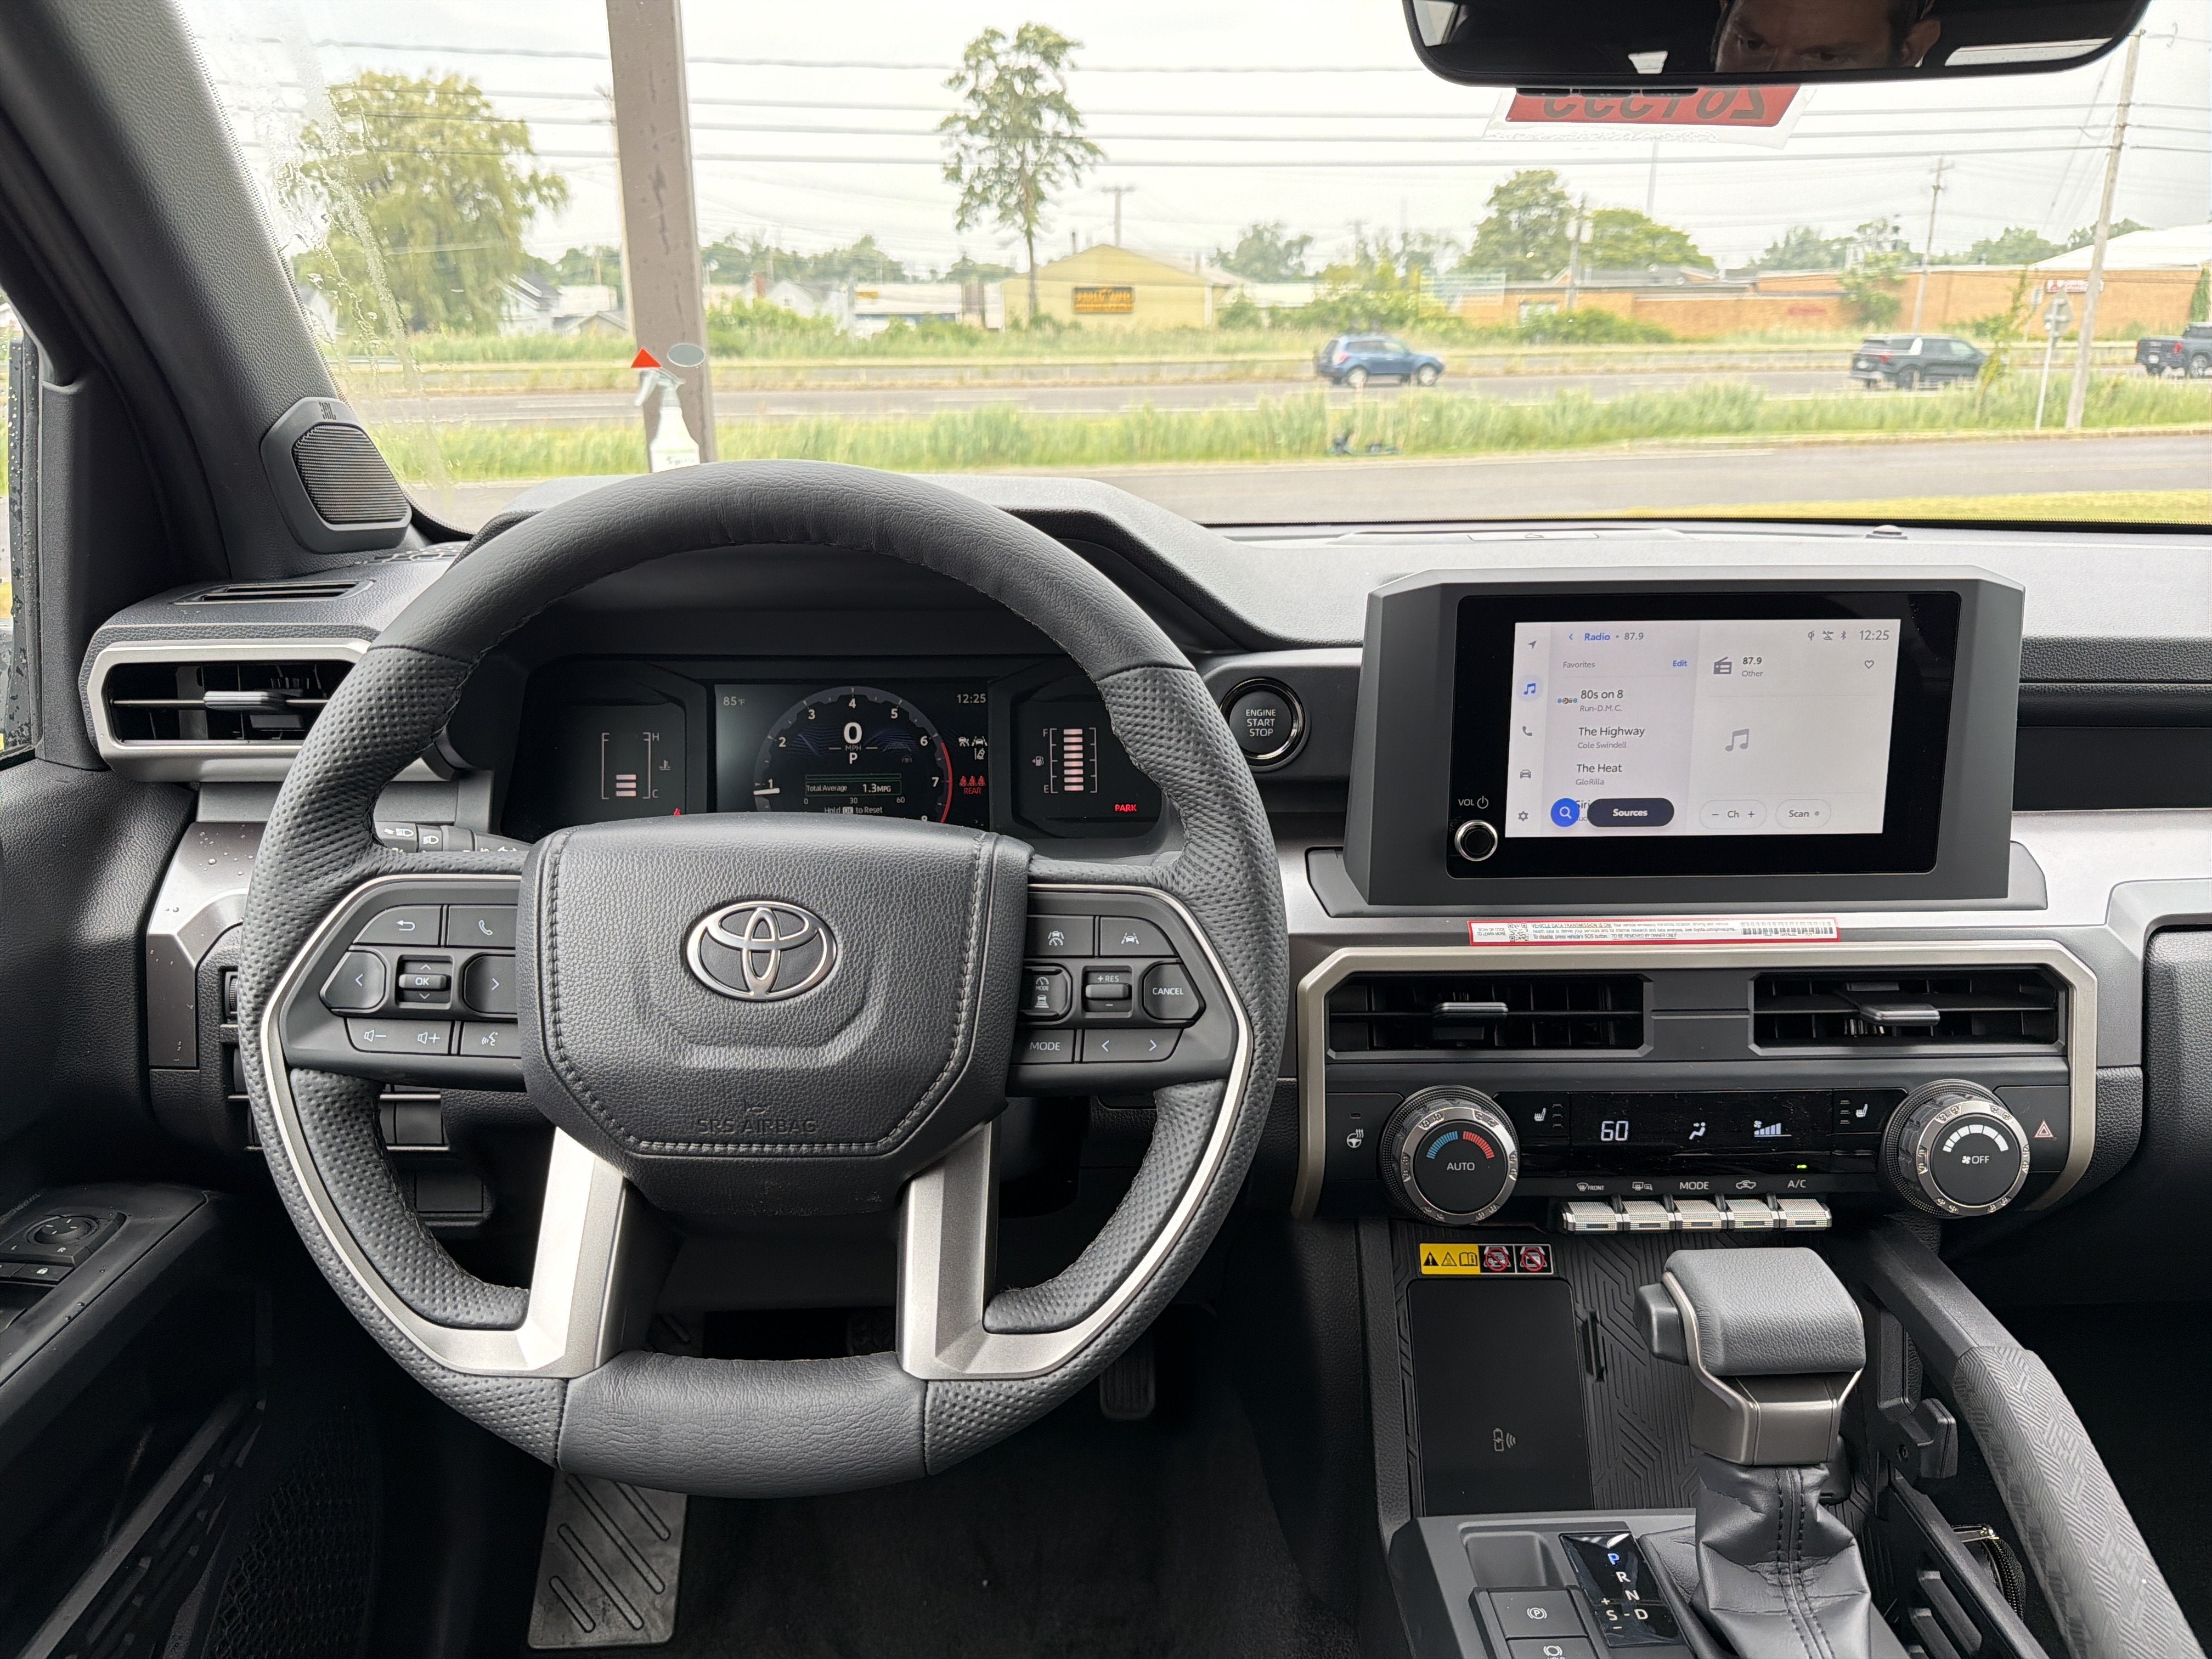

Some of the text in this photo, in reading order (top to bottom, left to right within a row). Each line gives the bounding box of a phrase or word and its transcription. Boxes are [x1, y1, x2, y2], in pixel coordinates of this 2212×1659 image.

[1859, 630, 1889, 641] 12:25
[1742, 657, 1762, 665] 87.9
[957, 693, 986, 703] 12:25
[1581, 690, 1598, 699] 80s
[1617, 690, 1623, 699] 8
[848, 698, 856, 708] 4
[808, 709, 816, 720] 3
[890, 708, 899, 719] 5
[1247, 718, 1276, 727] START
[652, 733, 659, 741] H
[843, 722, 862, 744] 0
[1043, 729, 1048, 737] F
[1249, 728, 1273, 737] STOP
[1578, 726, 1645, 738] The Highway
[778, 737, 787, 747] 2
[920, 736, 928, 746] 6
[849, 752, 858, 764] P
[1576, 764, 1622, 773] The Heat
[768, 778, 774, 788] 1
[932, 777, 939, 787] 7
[652, 789, 659, 798] C
[1043, 785, 1049, 793] E
[1612, 808, 1648, 816] Sources
[415, 977, 430, 986] OK
[1030, 1042, 1061, 1051] MODE
[1600, 1120, 1629, 1141] 60
[1972, 1155, 1990, 1164] OFF
[1446, 1161, 1475, 1171] AUTO
[1679, 1181, 1709, 1190] MODE
[1787, 1179, 1807, 1188] A/C
[1607, 1553, 1621, 1565] P
[1616, 1571, 1631, 1583] R
[1624, 1589, 1640, 1601] N
[1606, 1609, 1649, 1621] S D
